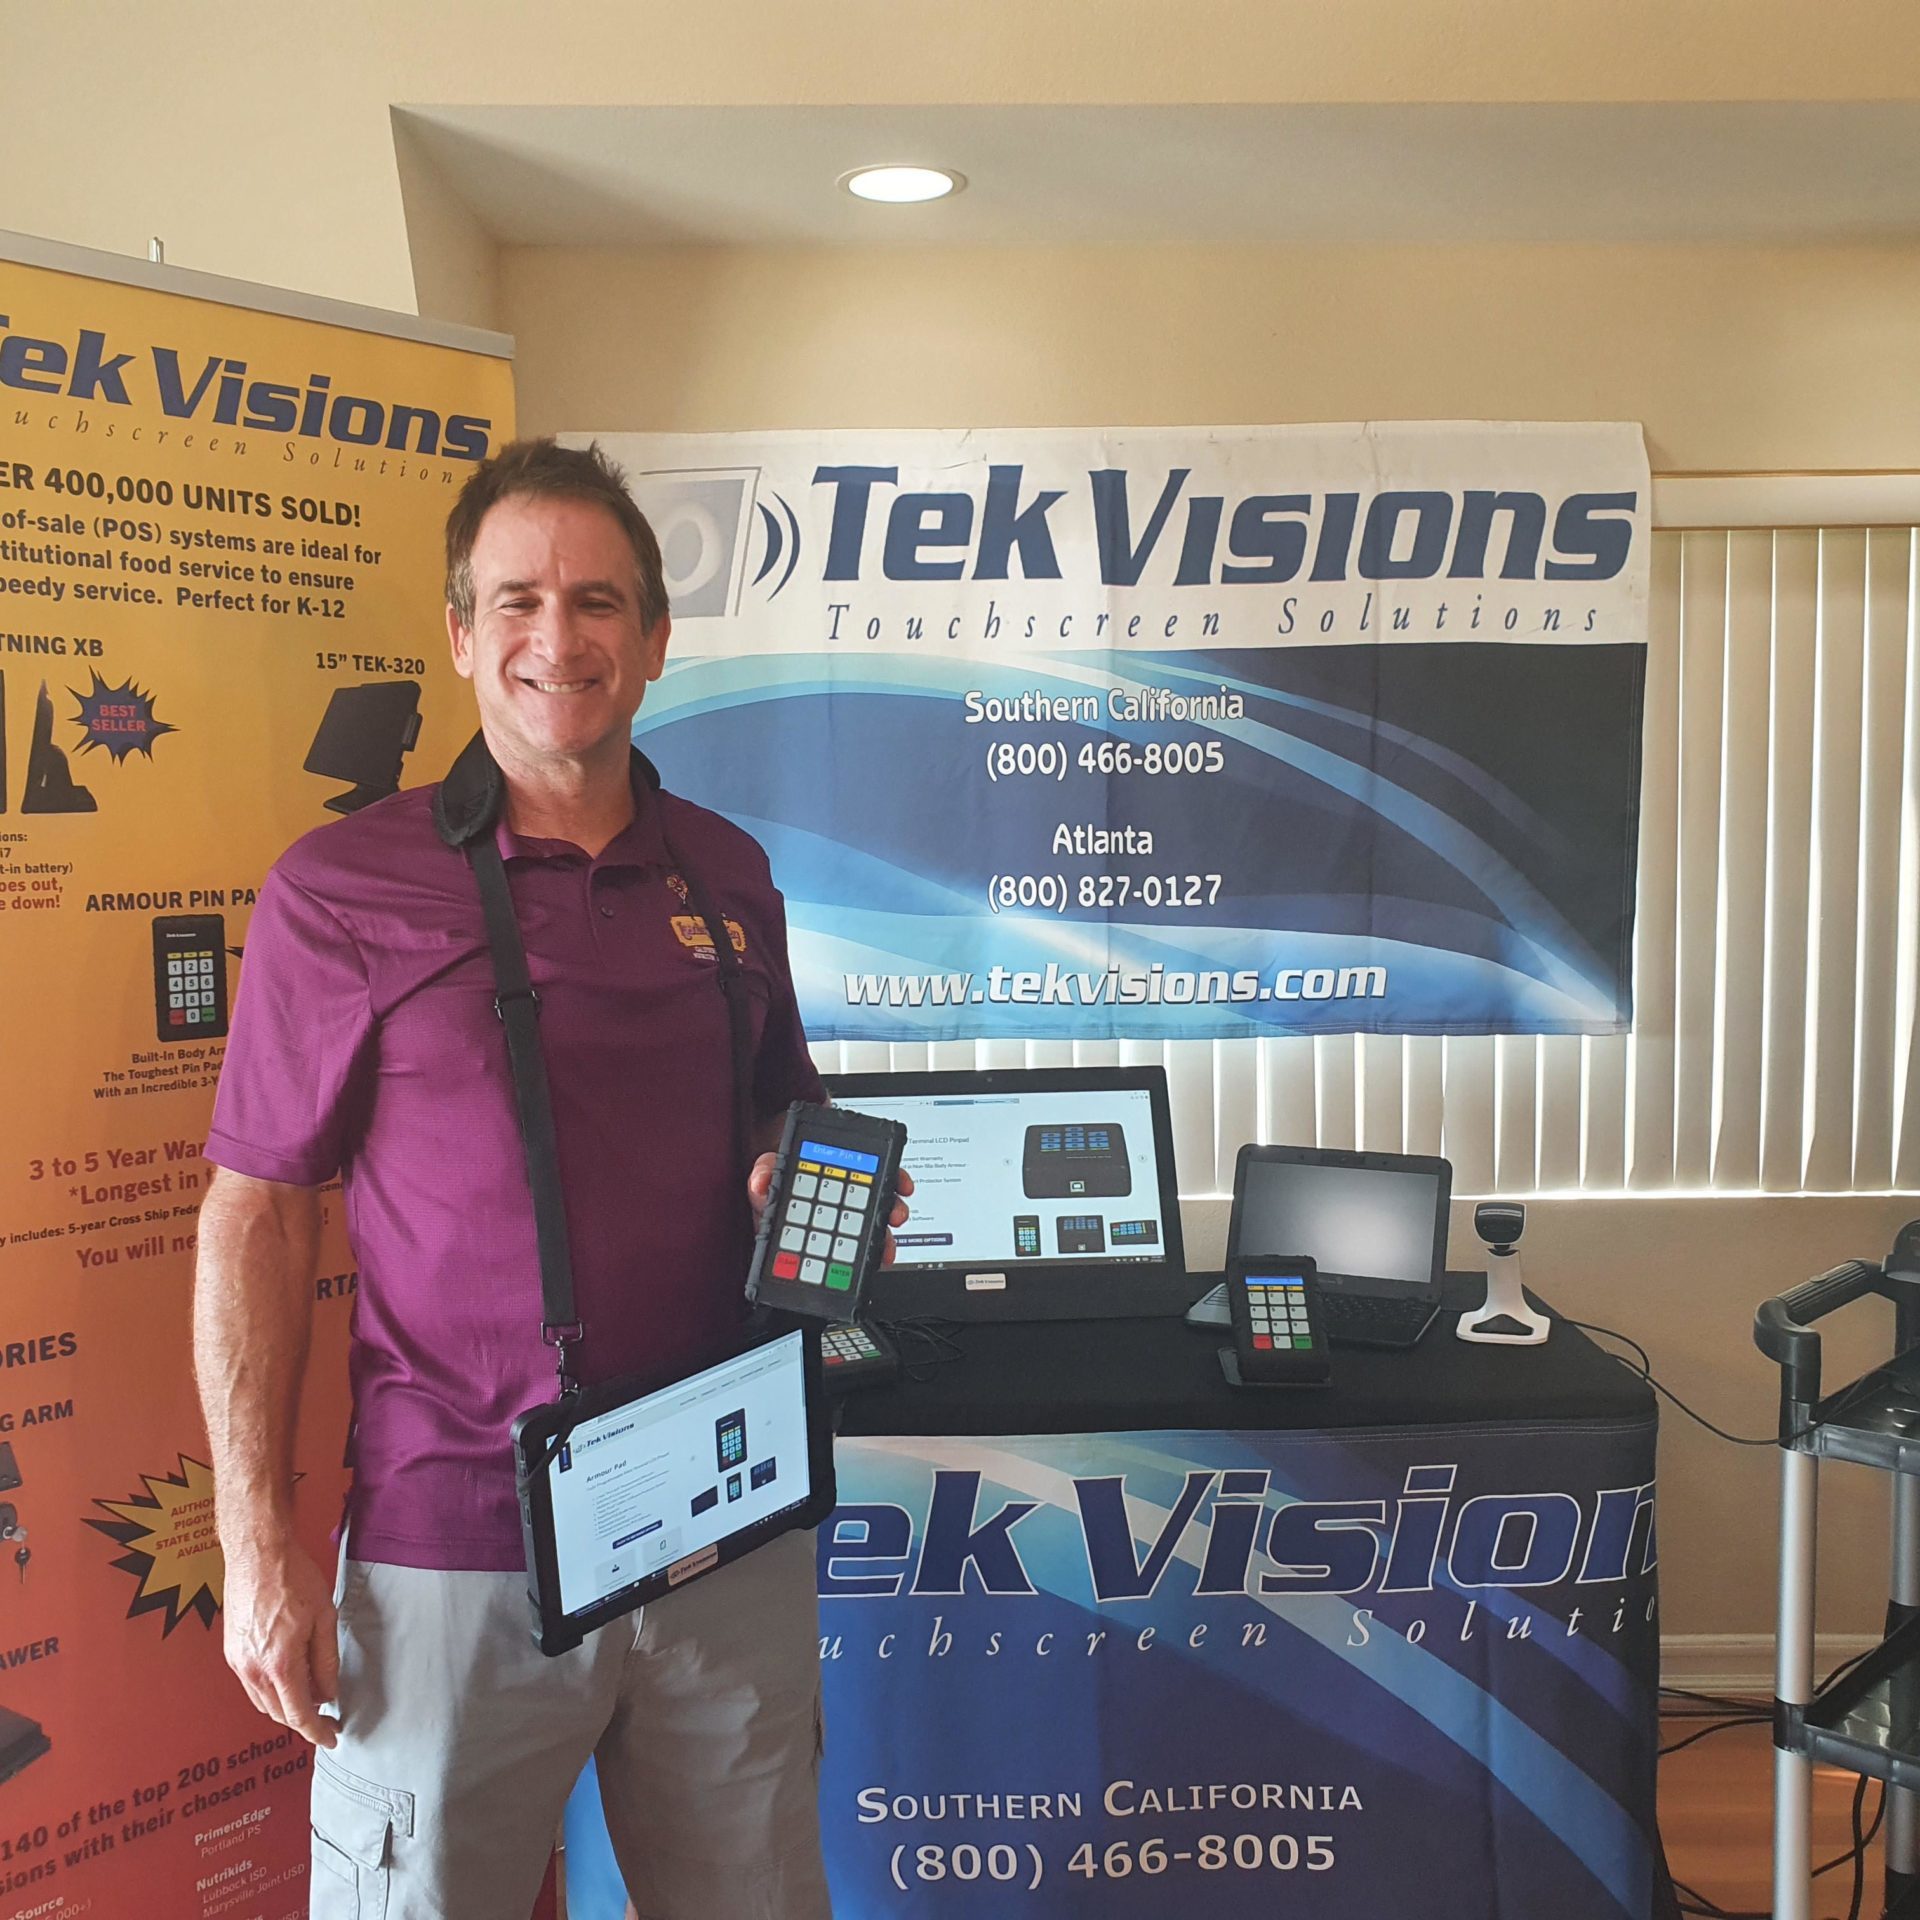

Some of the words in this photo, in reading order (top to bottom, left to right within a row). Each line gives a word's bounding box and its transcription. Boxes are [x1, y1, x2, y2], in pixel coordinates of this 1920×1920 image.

[0, 314, 136, 405] ek
[151, 346, 492, 461] Visions
[15, 410, 247, 455] uchscreen
[0, 461, 35, 491] ER
[44, 467, 173, 506] 400,000
[183, 483, 272, 518] UNITS
[281, 495, 361, 528] SOLD!
[1, 508, 86, 536] of-sale
[94, 516, 162, 544] (POS)
[170, 528, 256, 553] systems
[263, 538, 295, 556] are
[302, 538, 348, 562] ideal
[355, 544, 381, 565] for
[811, 464, 1069, 581] Tek
[1088, 467, 1637, 587] Visions
[0, 540, 113, 569] titutional
[120, 551, 171, 574] food
[179, 560, 255, 582] service
[261, 564, 282, 584] to
[289, 571, 355, 590] ensure
[74, 582, 163, 604] service.
[176, 586, 255, 612] Perfect
[262, 593, 290, 615] for
[297, 596, 346, 618] K-12
[828, 600, 1222, 640] Touchscreen
[1278, 592, 1597, 635] Solutions
[73, 637, 104, 657] XB
[353, 655, 426, 675] TEK-320
[100, 704, 137, 718] BEST
[964, 689, 1099, 724] Southern
[1107, 685, 1245, 721] California
[91, 718, 147, 732] SELLER
[986, 740, 1068, 782] (800)
[1077, 740, 1225, 775] 466-8005
[1052, 822, 1154, 855] Atlanta
[25, 862, 73, 875] battery)
[31, 876, 63, 893] out,
[12, 894, 60, 911] down!
[85, 891, 183, 913] ARMOUR
[189, 890, 225, 908] PIN
[231, 888, 262, 906] PA
[987, 874, 1068, 914] (800)
[1078, 873, 1224, 907] 827-0127
[844, 962, 1388, 1008] www.tekvisions.com
[103, 1071, 125, 1082] The
[128, 1065, 178, 1081] Toughest
[182, 1062, 200, 1074] Pin
[132, 1051, 174, 1064] Built-In
[177, 1047, 205, 1060] Body
[93, 1087, 121, 1099] With
[124, 1087, 138, 1096] an
[141, 1079, 198, 1094] Incredible
[200, 1076, 218, 1087] 3-Y
[29, 1159, 44, 1181] 3
[52, 1157, 77, 1178] to
[84, 1151, 99, 1173] 5
[107, 1147, 157, 1169] Year
[178, 1172, 198, 1191] in
[10, 1225, 65, 1244] includes:
[68, 1219, 106, 1236] 5-year
[109, 1215, 141, 1228] Cross
[145, 1209, 170, 1222] Ship
[173, 1204, 200, 1218] Fede
[76, 1248, 118, 1269] You
[126, 1235, 164, 1260] will
[0, 1331, 77, 1369] RIES
[22, 1399, 74, 1428] ARM
[155, 1532, 190, 1550] STATE
[177, 1540, 220, 1559] AVAILA
[817, 1468, 1046, 1598] ek
[1072, 1464, 1657, 1603] Vision
[819, 1615, 1268, 1660] uchscreen
[1347, 1595, 1656, 1647] Solutio
[2, 1825, 48, 1861] 140
[57, 1811, 81, 1838] of
[88, 1800, 125, 1825] the
[132, 1779, 170, 1808] top
[177, 1757, 220, 1790] 200
[226, 1730, 293, 1770] school
[64, 1832, 114, 1868] with
[122, 1807, 175, 1843] their
[181, 1775, 256, 1819] chosen
[263, 1750, 308, 1785] food
[194, 1806, 271, 1846] PrimeroEdge
[201, 1832, 245, 1858] Portland
[247, 1824, 261, 1839] PS
[196, 1860, 253, 1892] Nutrikids
[283, 1863, 305, 1881] USD
[890, 1843, 1045, 1890] (800)
[1067, 1834, 1335, 1878] 466-8005
[203, 1877, 247, 1904] Lubbock
[250, 1866, 267, 1882] ISD
